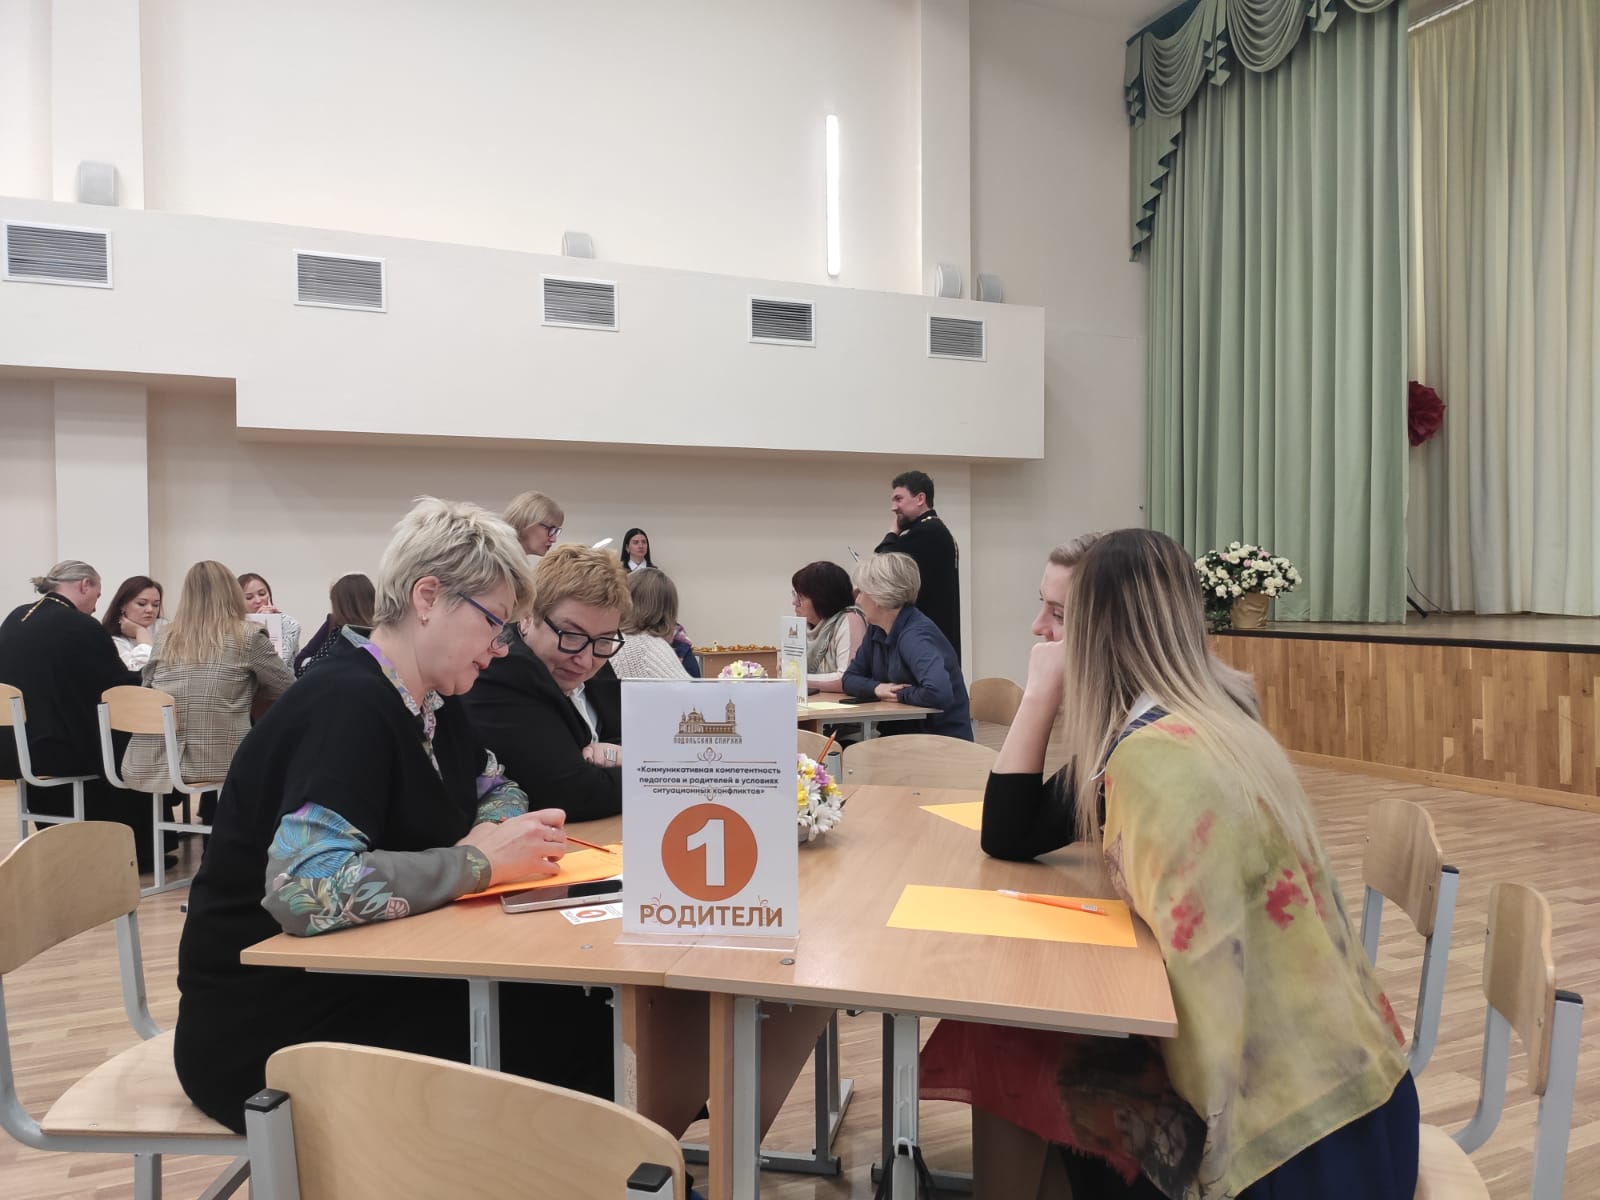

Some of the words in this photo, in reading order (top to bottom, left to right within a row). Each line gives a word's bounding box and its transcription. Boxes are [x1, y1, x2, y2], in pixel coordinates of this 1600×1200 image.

[637, 766, 714, 774] «Коммуникативная
[690, 776, 733, 784] родителей
[712, 787, 765, 795] конфликтов»
[687, 818, 725, 887] 1
[640, 904, 783, 928] РОДИТЕЛИ
